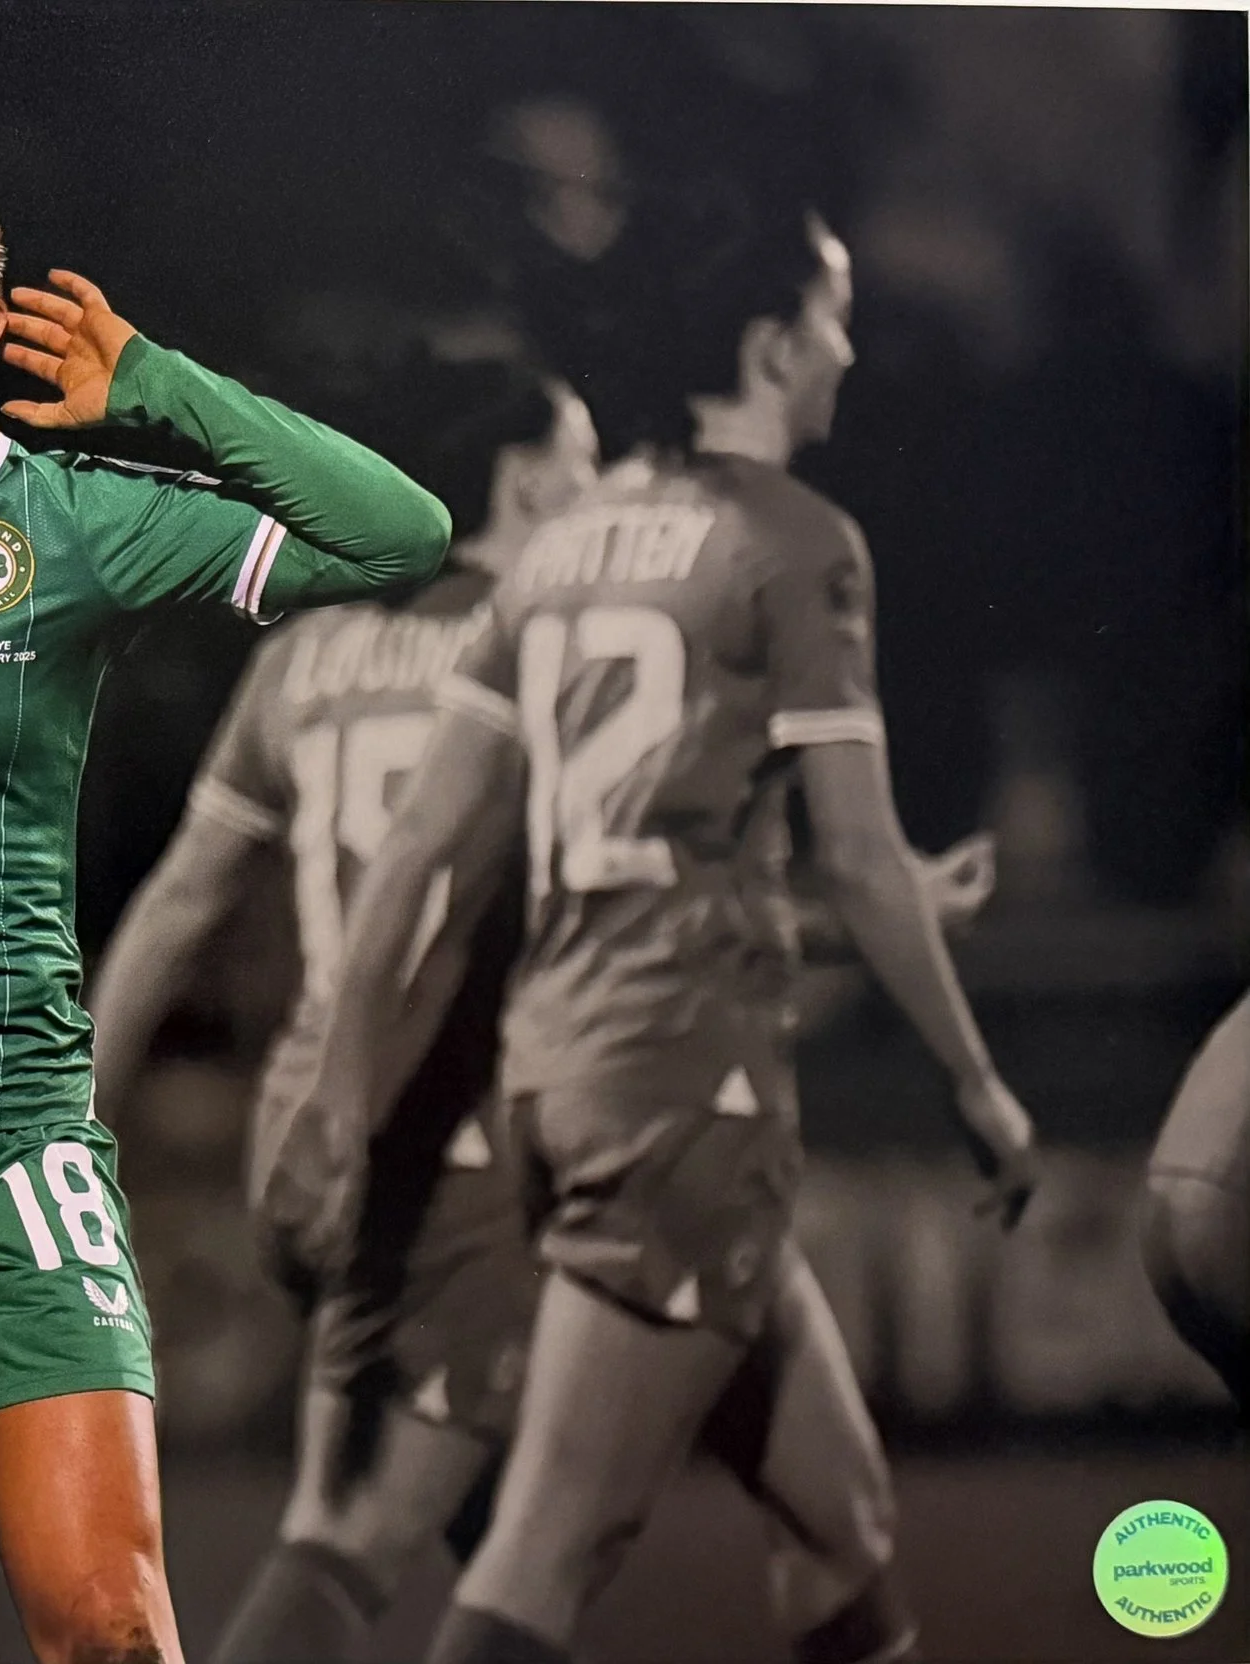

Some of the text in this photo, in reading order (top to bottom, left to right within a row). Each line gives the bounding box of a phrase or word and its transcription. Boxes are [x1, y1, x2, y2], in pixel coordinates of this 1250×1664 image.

[13, 651, 37, 662] 2025
[518, 605, 686, 898] 12
[1114, 1512, 1211, 1546] AUTHENTIC
[1113, 1557, 1213, 1581] parkwood
[1114, 1591, 1212, 1623] AUTHENTIC
